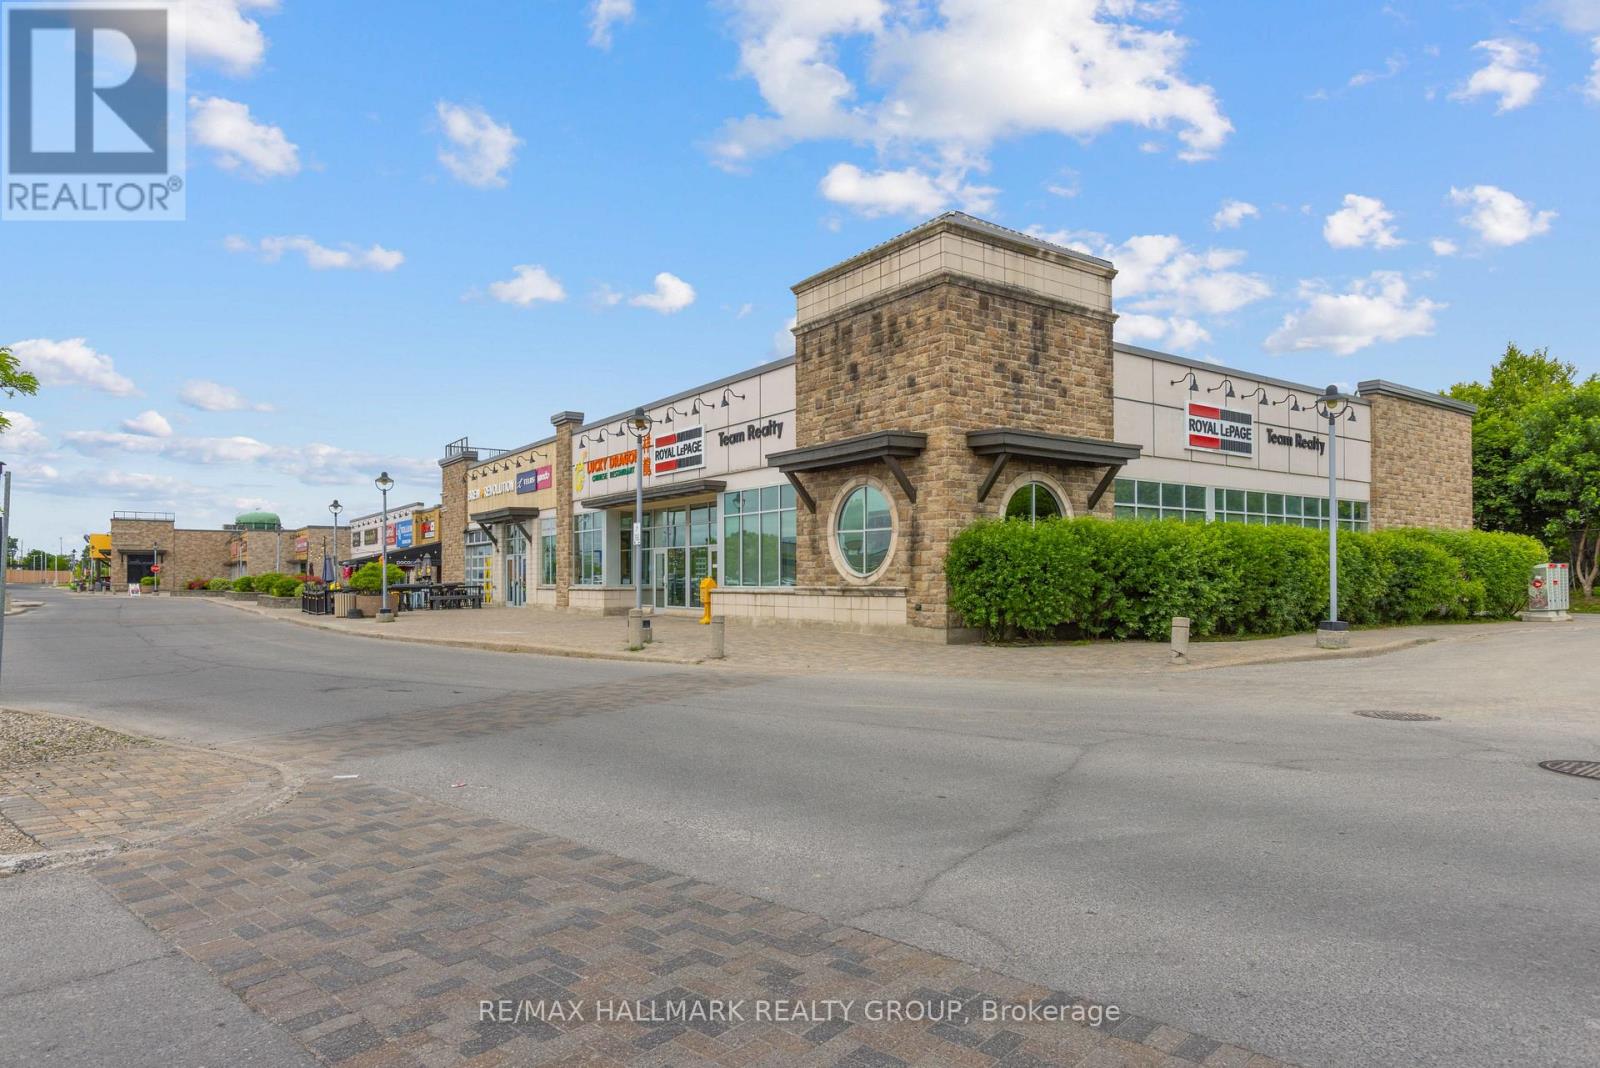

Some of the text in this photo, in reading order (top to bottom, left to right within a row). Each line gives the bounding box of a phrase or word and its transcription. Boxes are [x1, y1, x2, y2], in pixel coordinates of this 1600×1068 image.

[718, 420, 784, 447] Team Realty
[1189, 418, 1219, 435] ROYAL
[1266, 427, 1325, 456] Team Realty
[587, 457, 608, 474] LUCKY
[609, 449, 637, 468] DRAGON
[655, 447, 676, 461] ROYAL
[484, 481, 515, 497] REVOLUTION
